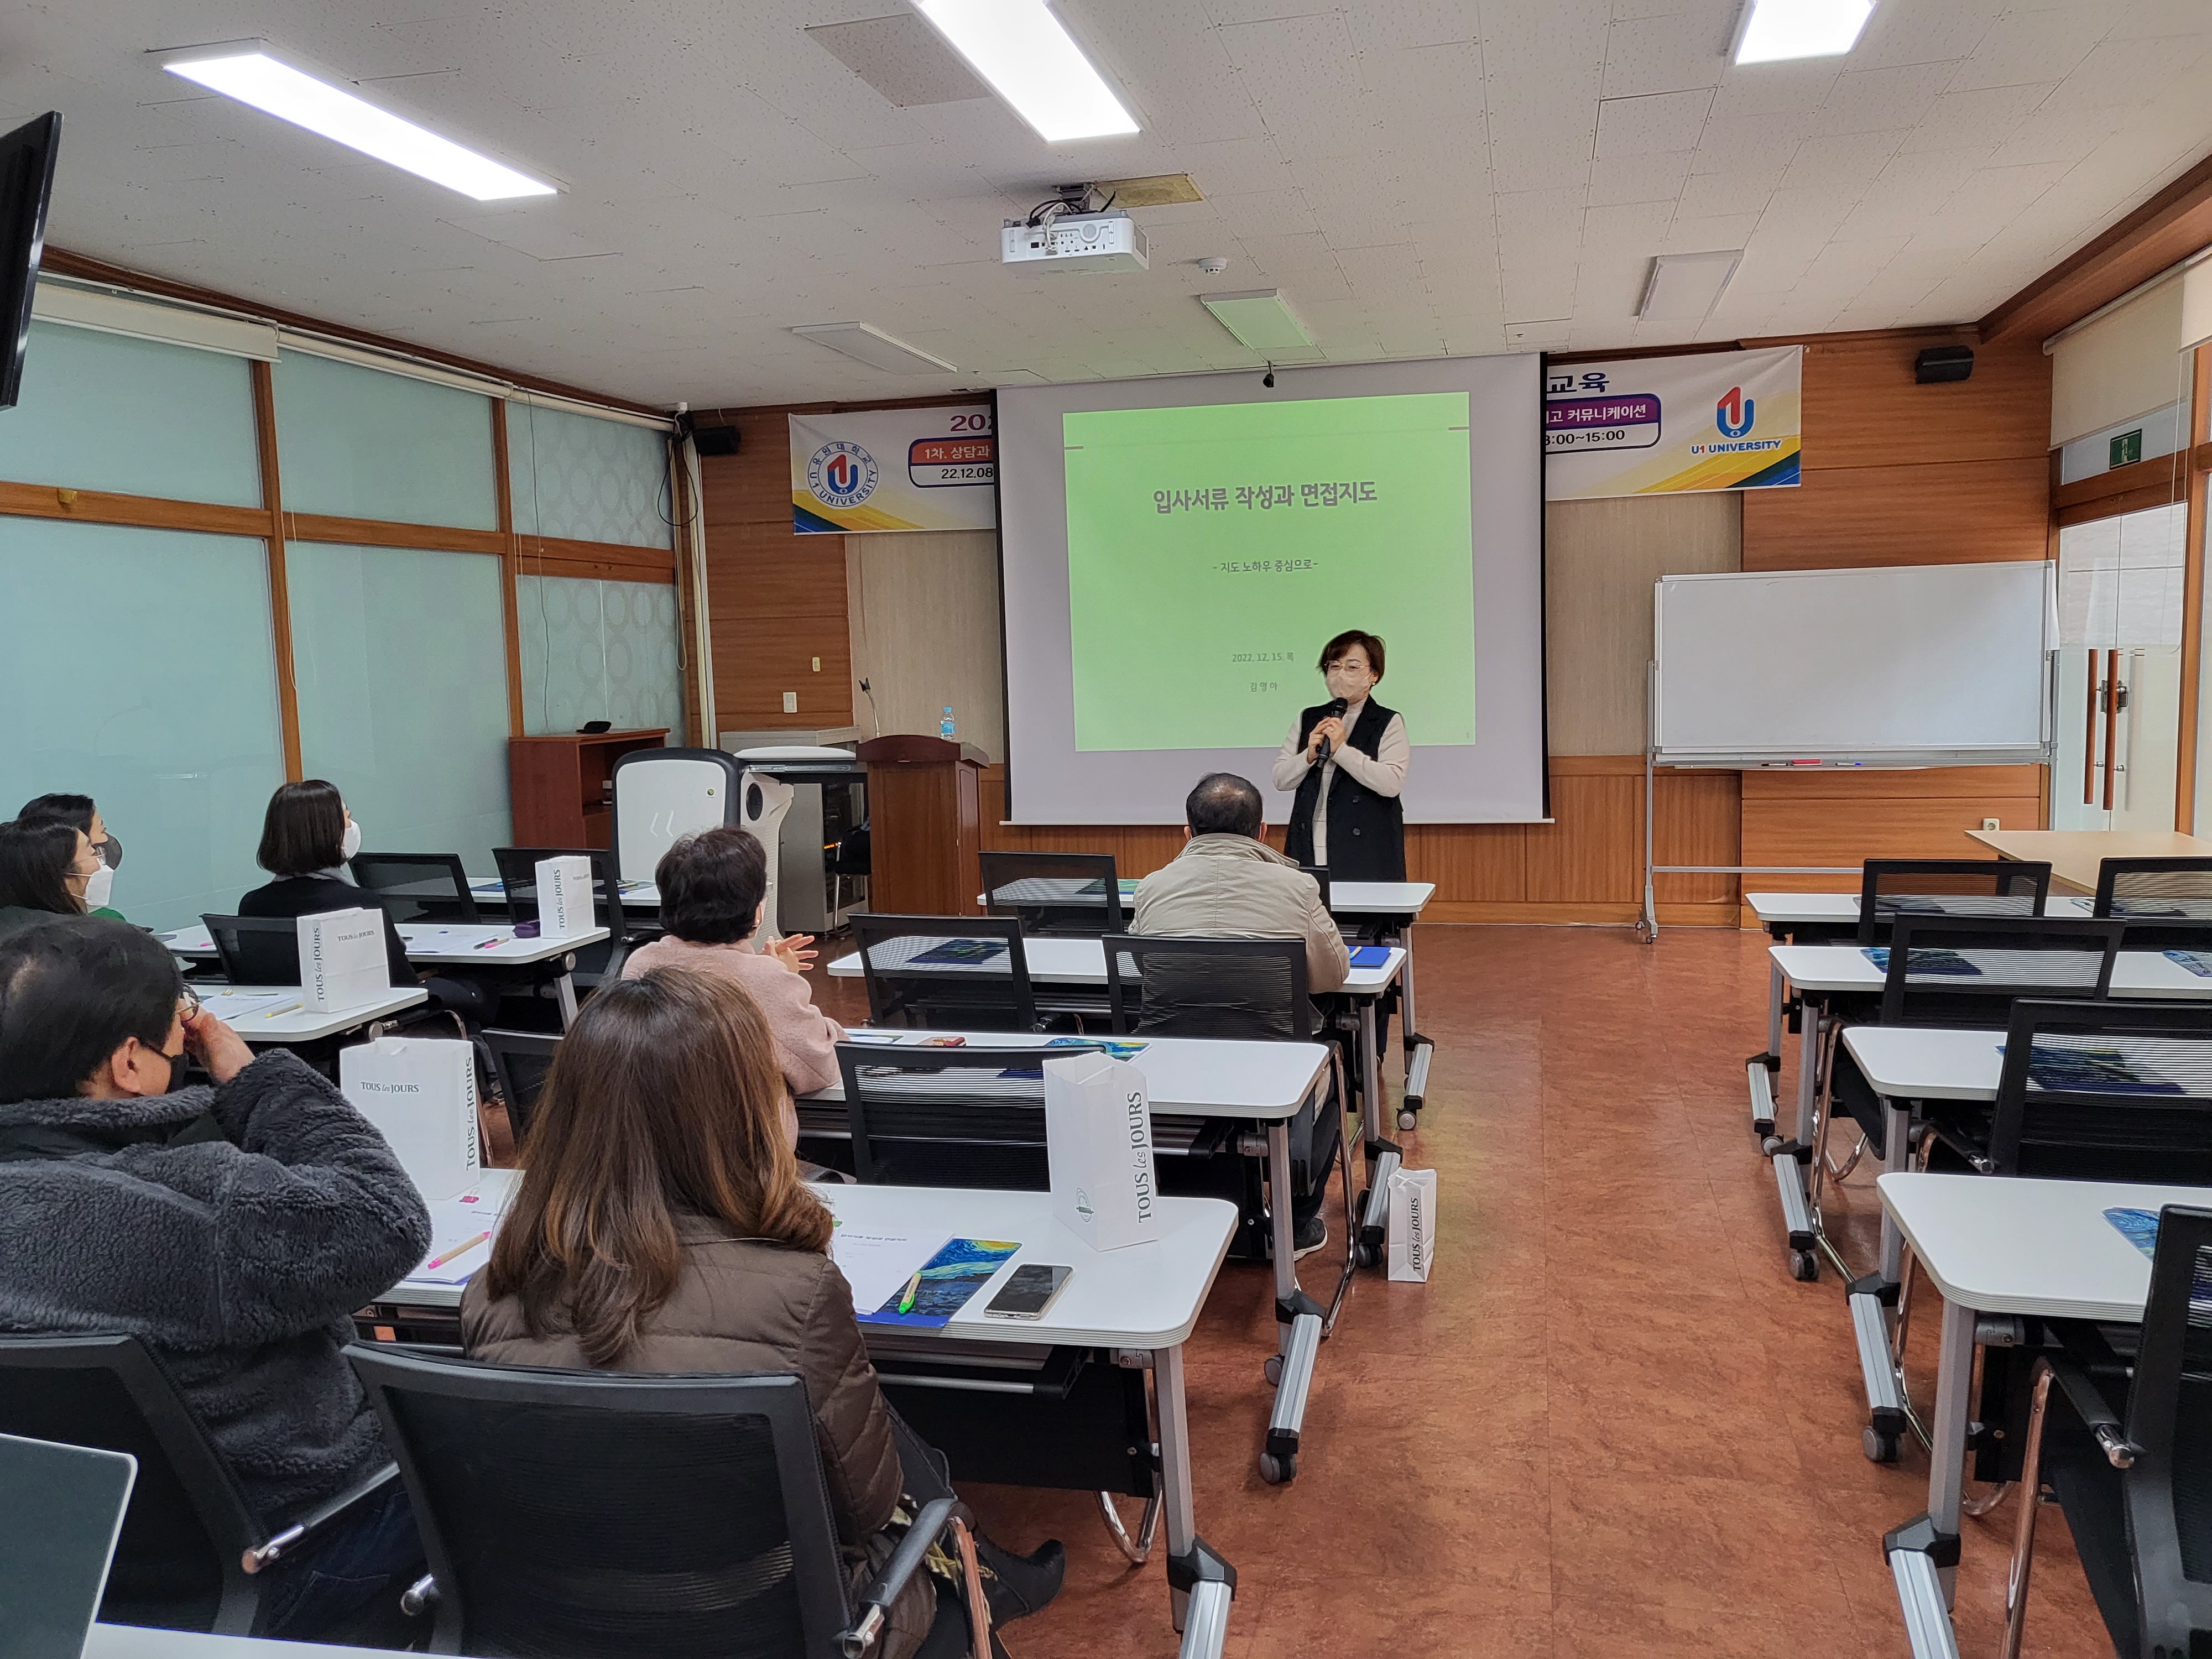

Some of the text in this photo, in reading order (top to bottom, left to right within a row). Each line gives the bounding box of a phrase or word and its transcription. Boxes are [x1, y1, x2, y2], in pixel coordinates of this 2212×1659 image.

[1546, 372, 1610, 394] 교육
[1567, 404, 1646, 422] 커뮤니케이션
[925, 445, 990, 460] 1차. 상담과
[1691, 440, 1781, 454] U1 UNIVERSITY
[941, 467, 994, 479] 22.12.08
[819, 469, 877, 505] UNIVERSITY
[1153, 481, 1378, 514] 입사서류 작성과 면접지도
[1220, 562, 1240, 573] 지도
[1242, 561, 1271, 572] 노하우
[1232, 654, 1255, 662] 2022.
[554, 869, 564, 896] JOURS
[359, 930, 374, 938] JOURS
[314, 927, 325, 1002] TOUS les JOURS
[361, 1082, 381, 1092] TOUS
[391, 1084, 419, 1094] JOURS
[466, 1057, 474, 1108] JOURS
[466, 1126, 476, 1171] TOUS
[1127, 1092, 1152, 1224] TOUS les JOURS
[1411, 1197, 1422, 1231] JOURS
[1412, 1243, 1421, 1272] TOUS
